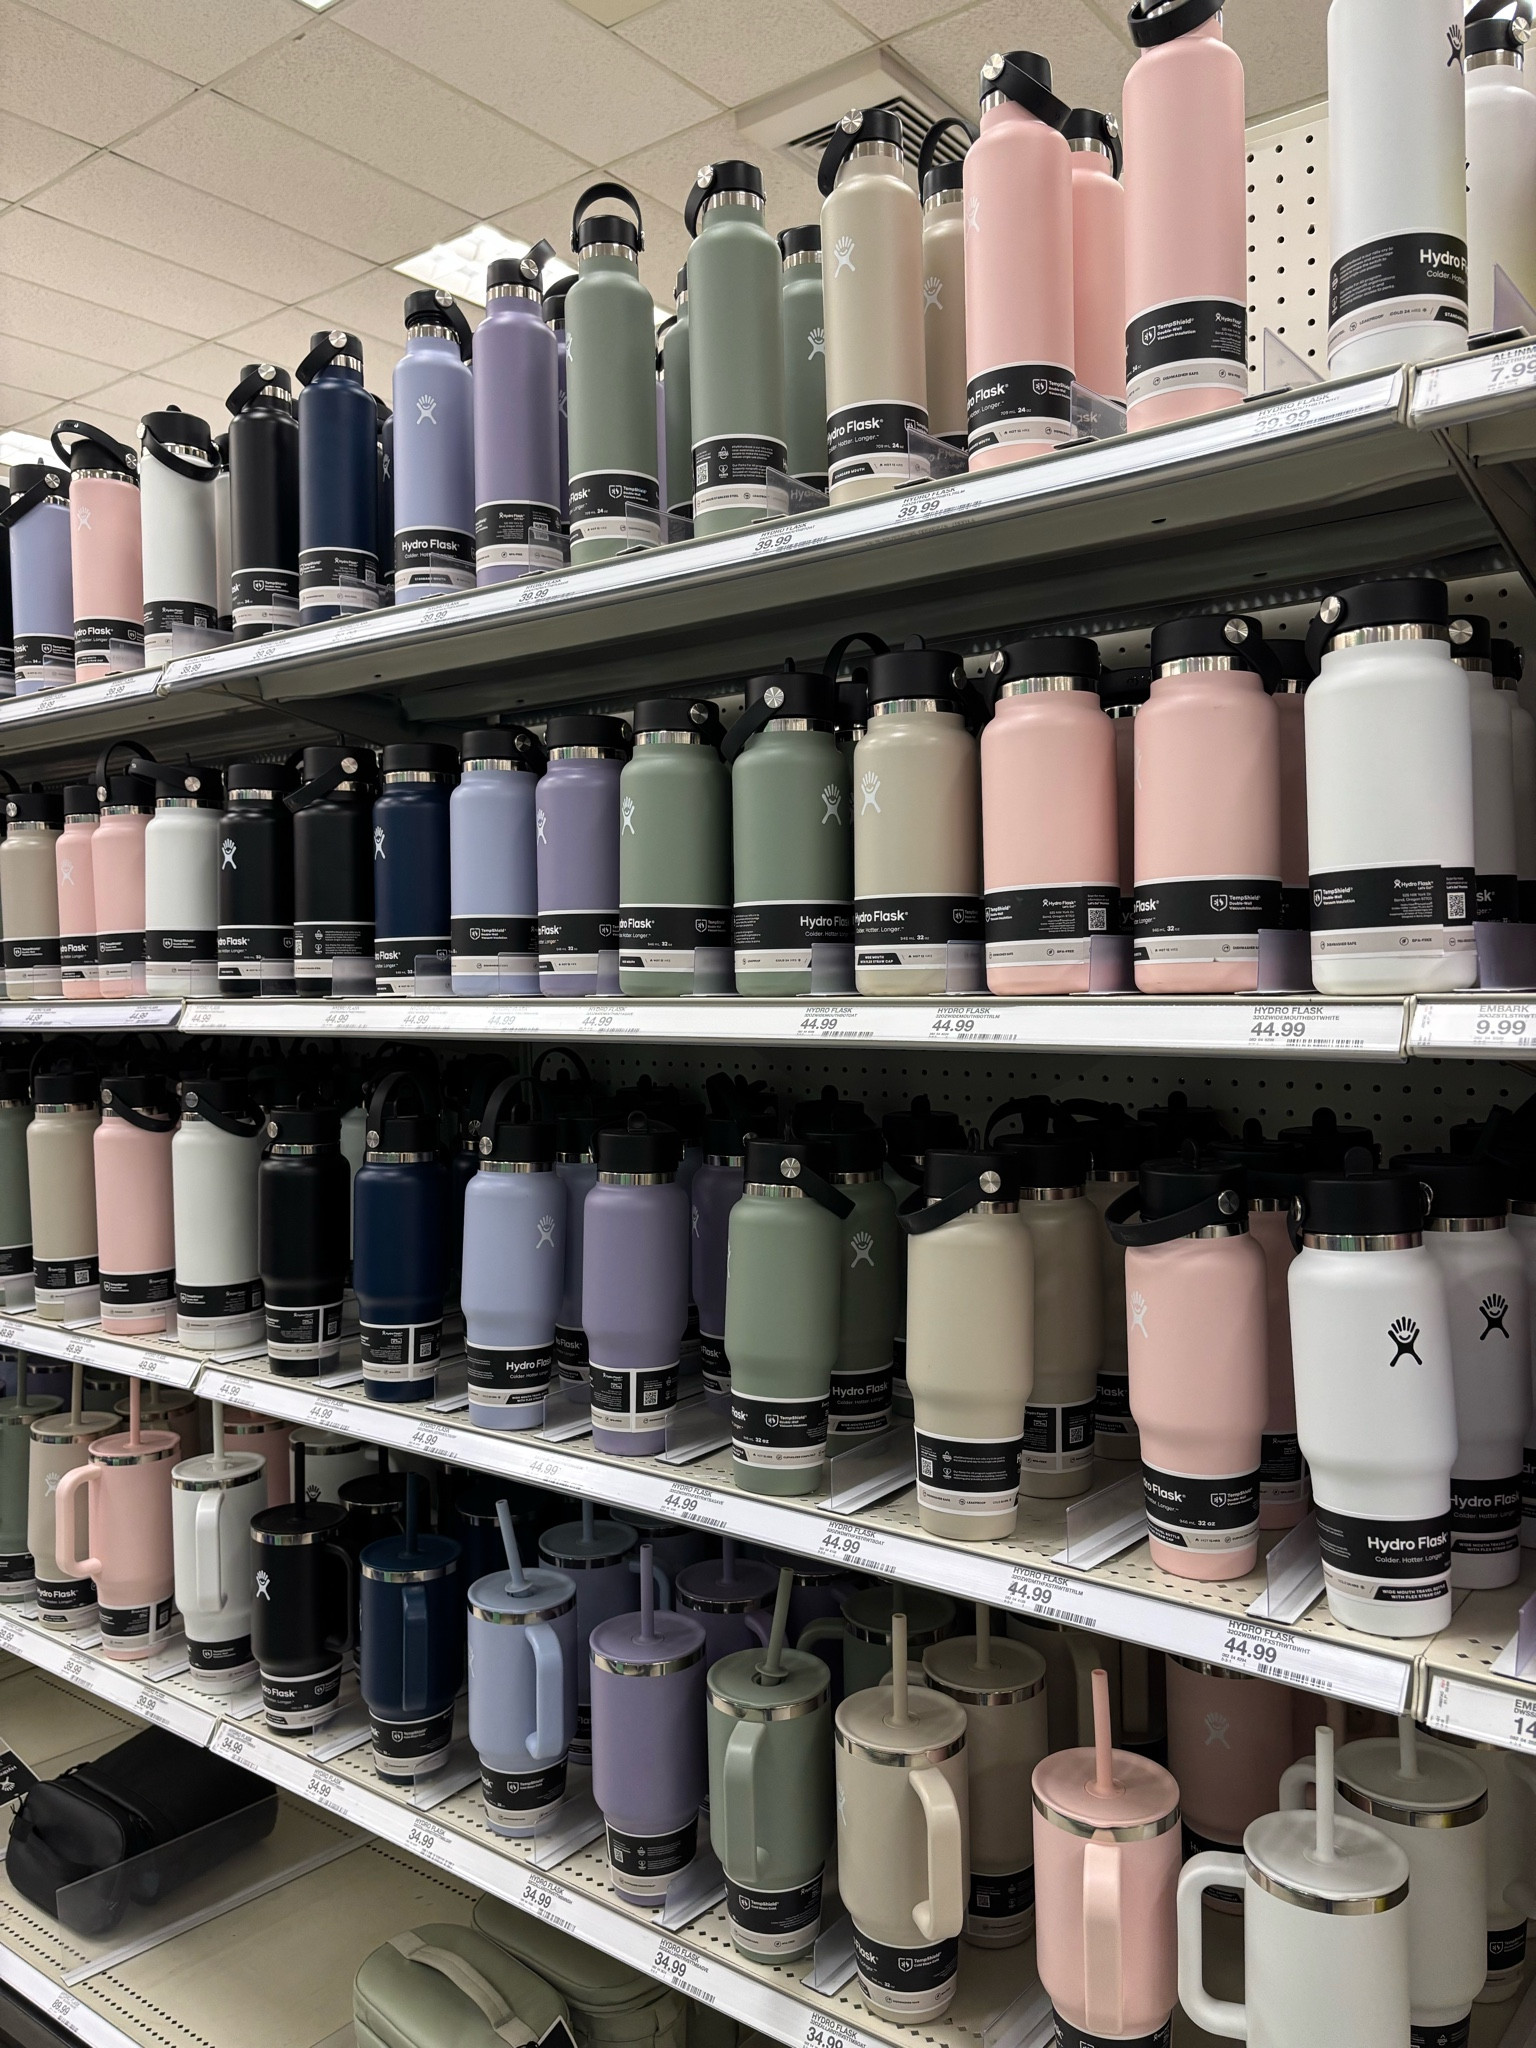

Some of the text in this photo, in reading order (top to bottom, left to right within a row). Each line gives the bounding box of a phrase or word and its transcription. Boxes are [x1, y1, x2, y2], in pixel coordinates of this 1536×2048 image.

[1420, 249, 1460, 269] Hydro
[1157, 318, 1192, 330] TempShield
[976, 383, 1005, 400] Flask
[1258, 394, 1329, 417] HYDRO FLASK
[847, 418, 880, 433] Flask
[1254, 409, 1311, 433] 39.99
[904, 487, 956, 504] HYDRO FLASK
[898, 500, 941, 519] 39.99
[761, 523, 807, 538] HYDRO FLASK
[402, 539, 458, 552] Hydro Flask
[755, 535, 792, 551] 39.99
[519, 589, 549, 602] 39.99
[421, 611, 447, 623] 39.99
[87, 627, 111, 636] Flask
[1323, 887, 1351, 895] TempShield
[1136, 898, 1157, 913] Flask
[628, 918, 652, 929] Flask
[800, 915, 833, 930] Hydro
[873, 910, 905, 922] Flask
[541, 925, 560, 936] Flask
[68, 944, 87, 952] Flask
[226, 937, 248, 946] Flask
[380, 950, 399, 960] Flask
[1480, 1005, 1529, 1013] EMBARK
[325, 1014, 349, 1024] 44.99
[404, 1015, 429, 1024] 44.99
[582, 1017, 613, 1027] 44.99
[800, 1018, 838, 1030] 44.99
[932, 1019, 975, 1032] 44.99
[1251, 1022, 1306, 1037] 44.99
[1476, 1020, 1526, 1035] 9.99
[560, 1339, 581, 1350] Flask
[506, 1361, 536, 1373] Hydro
[220, 1384, 241, 1396] 44.99
[832, 1383, 888, 1399] Hydro Flask
[1096, 1386, 1124, 1397] Flask
[309, 1406, 333, 1420] 44.99
[412, 1432, 438, 1446] 44.99
[529, 1460, 559, 1475] 44.99
[672, 1483, 713, 1498] HYDRO FLASK
[1152, 1484, 1182, 1503] Flask
[665, 1495, 698, 1512] 44.99
[828, 1521, 876, 1538] HYDRO FLASK
[822, 1534, 861, 1554] 44.99
[1367, 1535, 1416, 1554] Hydro
[1418, 1531, 1447, 1549] Flask
[1375, 1555, 1401, 1564] Colder.
[1402, 1555, 1424, 1564] Hotter.
[1013, 1567, 1069, 1586] HYDRO FLASK
[54, 1590, 76, 1598] Flask
[1008, 1581, 1052, 1604] 44.99
[1229, 1620, 1295, 1644] HYDRO FLASK
[1224, 1637, 1277, 1664] 44.99
[64, 1661, 82, 1675] 39.99
[272, 1688, 295, 1698] Flask
[137, 1695, 157, 1710] 39.99
[221, 1737, 244, 1754] 34.99
[308, 1778, 331, 1798] 34.99
[415, 1817, 446, 1836] HYDRO FLASK
[408, 1828, 434, 1849] 34.99
[529, 1874, 564, 1895] HYDRO FLASK
[523, 1885, 552, 1908] 34.99
[660, 1938, 701, 1963] HYDRO FLASK
[914, 1953, 941, 1963] TempShield
[654, 1951, 687, 1977] 34.99
[52, 1999, 71, 2016] 89.99
[811, 2012, 858, 2039] HYDRO FLASK
[806, 2026, 843, 2048] 34.99
